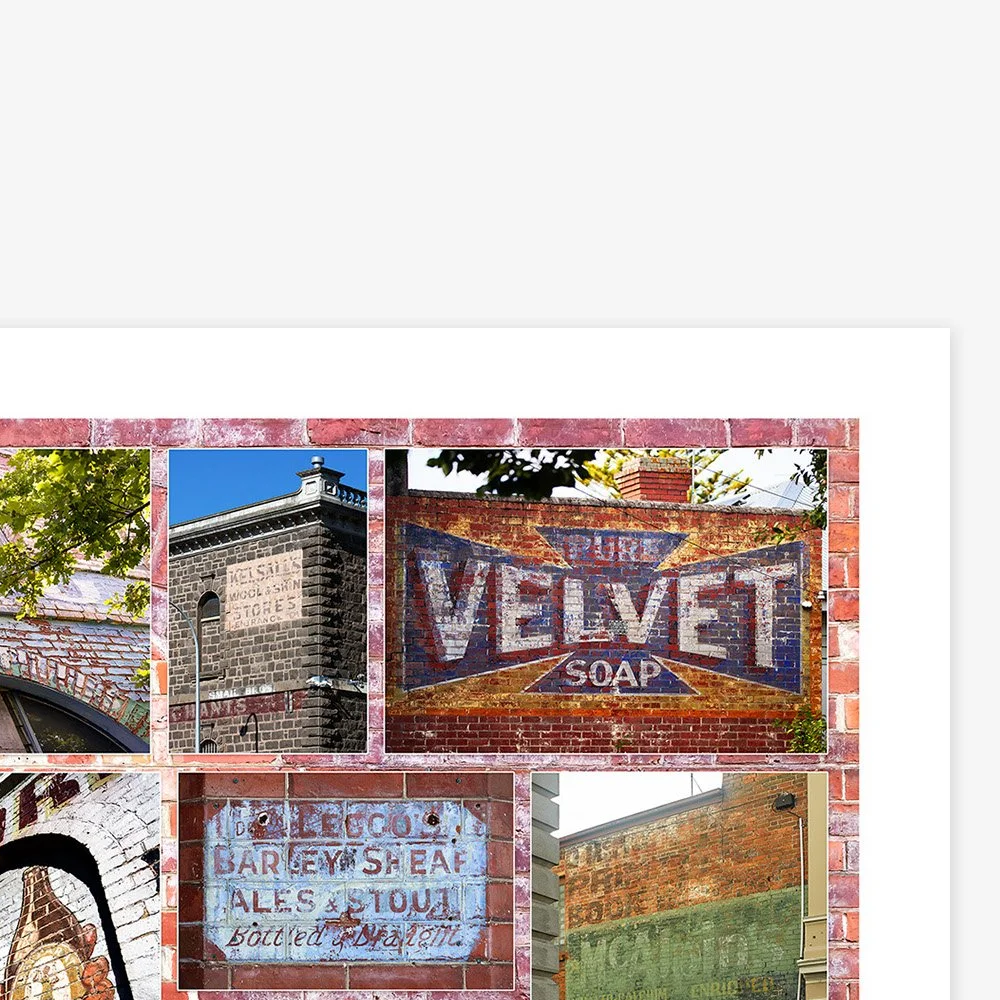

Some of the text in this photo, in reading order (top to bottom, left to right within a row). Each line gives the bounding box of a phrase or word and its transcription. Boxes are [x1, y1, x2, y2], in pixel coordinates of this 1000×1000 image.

[415, 558, 800, 668] VELVET
[565, 658, 662, 688] SOAP
[213, 846, 342, 875] BARLEY
[230, 888, 316, 914] ALES
